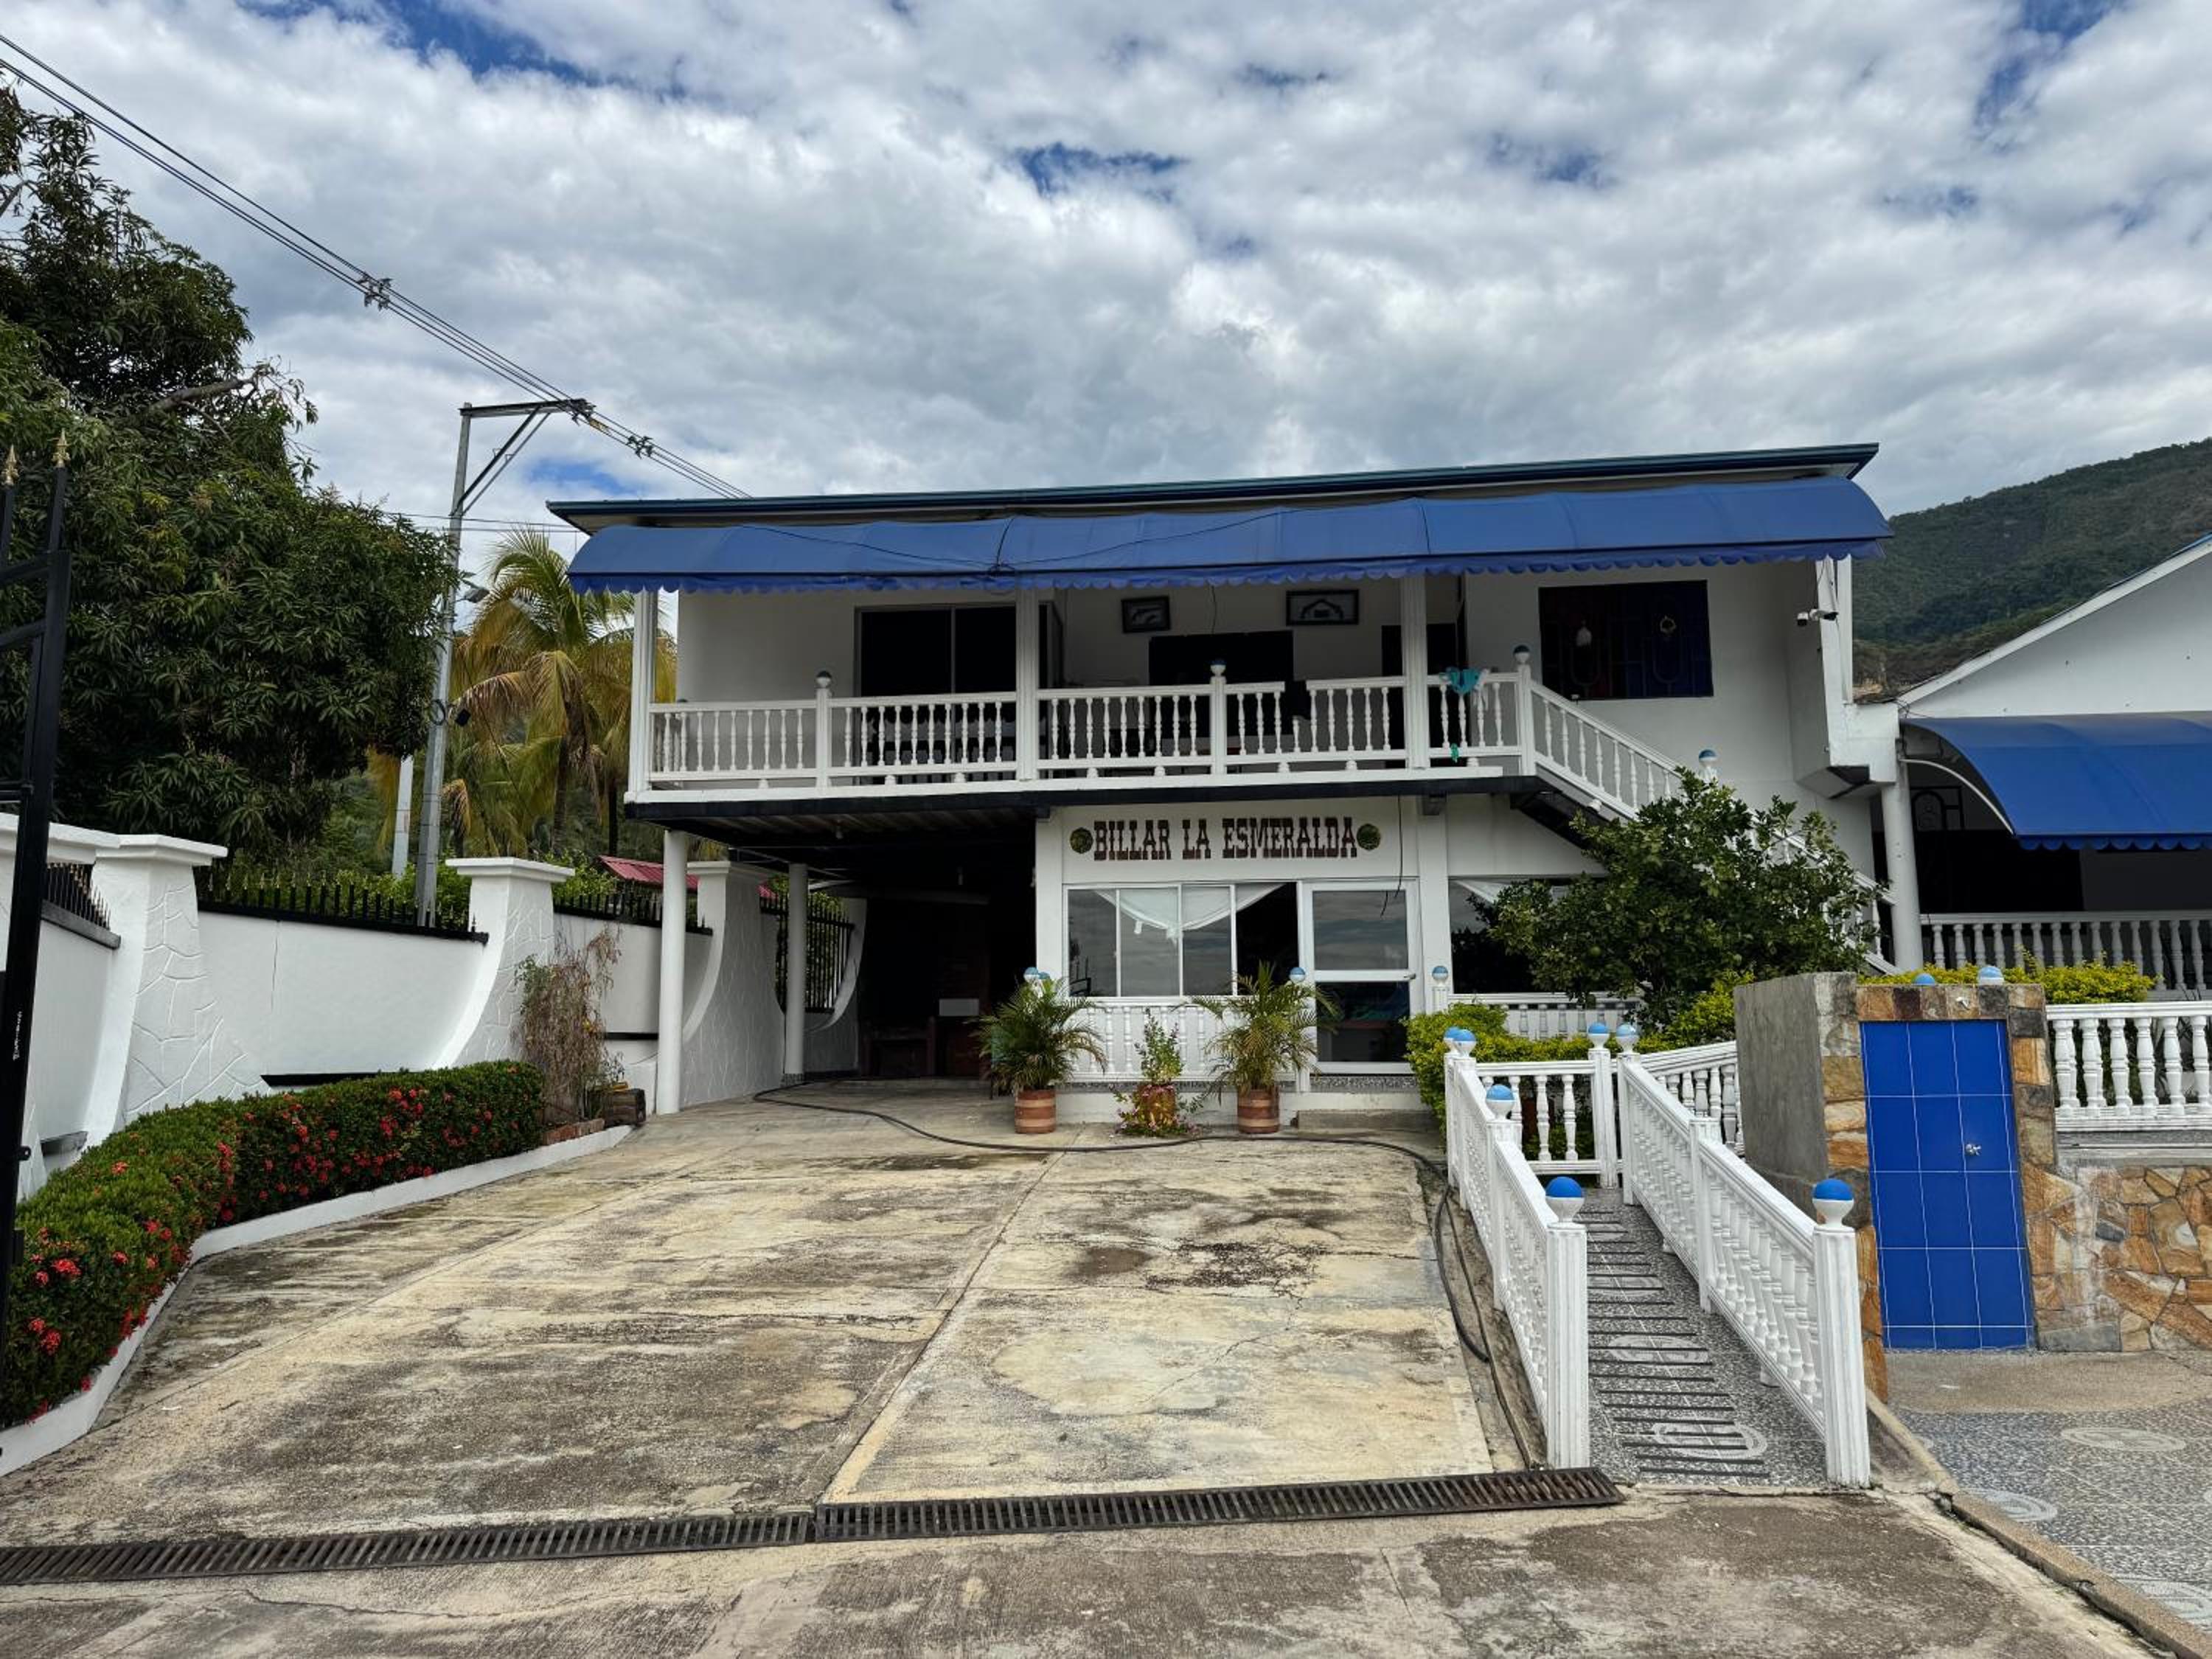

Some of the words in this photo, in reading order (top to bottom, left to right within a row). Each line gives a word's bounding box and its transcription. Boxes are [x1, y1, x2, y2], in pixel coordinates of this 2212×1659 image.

[1094, 819, 1171, 860] BILLAR
[1183, 819, 1211, 859] LA
[1222, 817, 1357, 858] ESMERALDA
